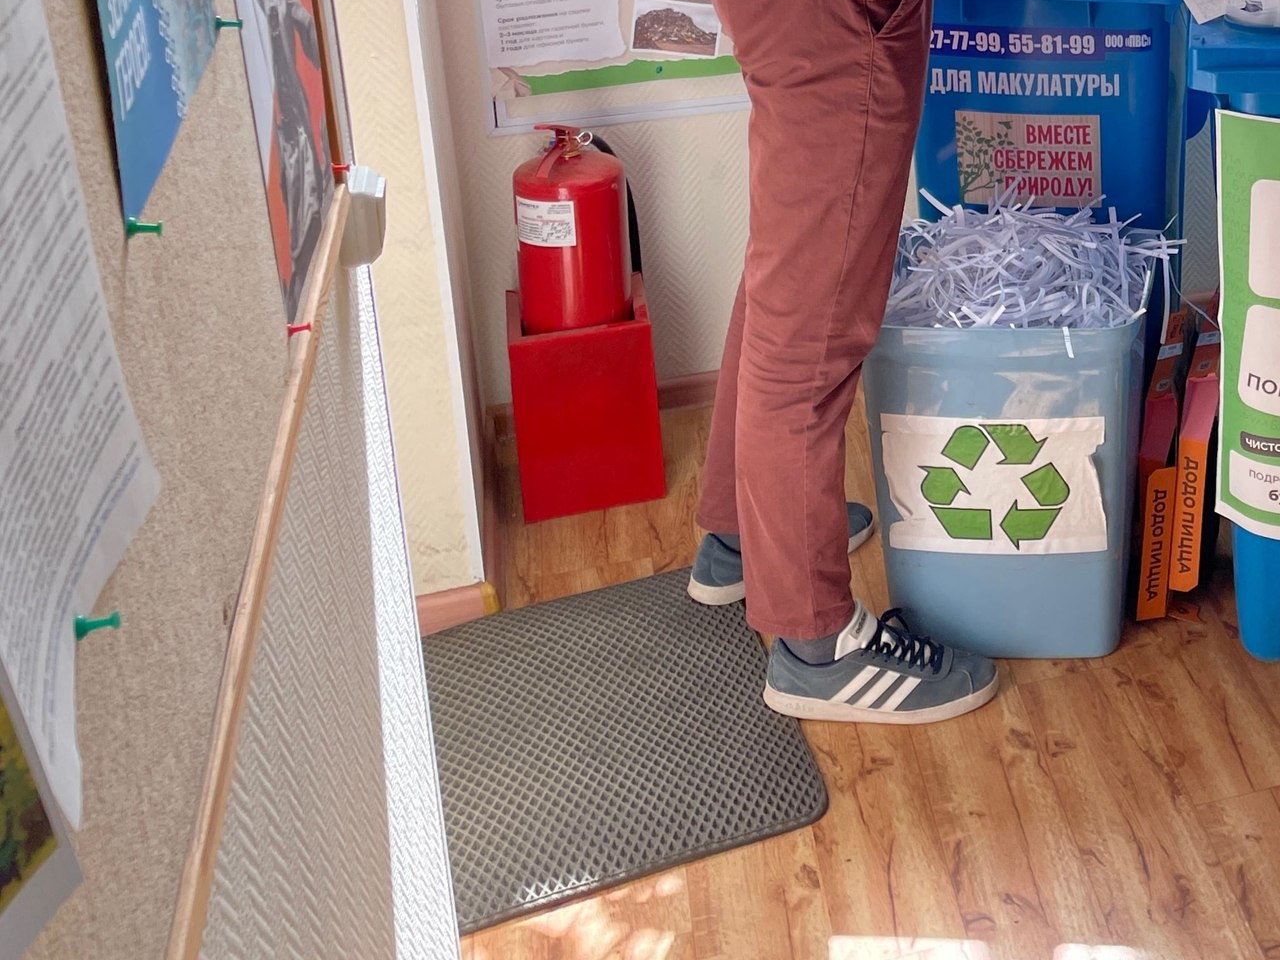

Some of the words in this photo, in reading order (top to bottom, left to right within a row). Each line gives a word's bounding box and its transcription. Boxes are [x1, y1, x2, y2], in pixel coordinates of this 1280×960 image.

[1008, 33, 1096, 55] 55-81-99
[1104, 34, 1124, 48] ООО
[929, 68, 972, 95] ДЛЯ
[977, 70, 1120, 97] МАКУЛАТУРЫ
[1025, 124, 1092, 145] ВМЕСТЕ
[994, 149, 1093, 172] СБЕРЕЖЕМ
[1004, 176, 1093, 198] ПРИРОДУ!
[1182, 456, 1199, 509] ДОДО
[1151, 488, 1168, 538] ДОДО
[1176, 512, 1196, 574] ПИЦЦА
[1145, 540, 1163, 602] ПИЦЦА
